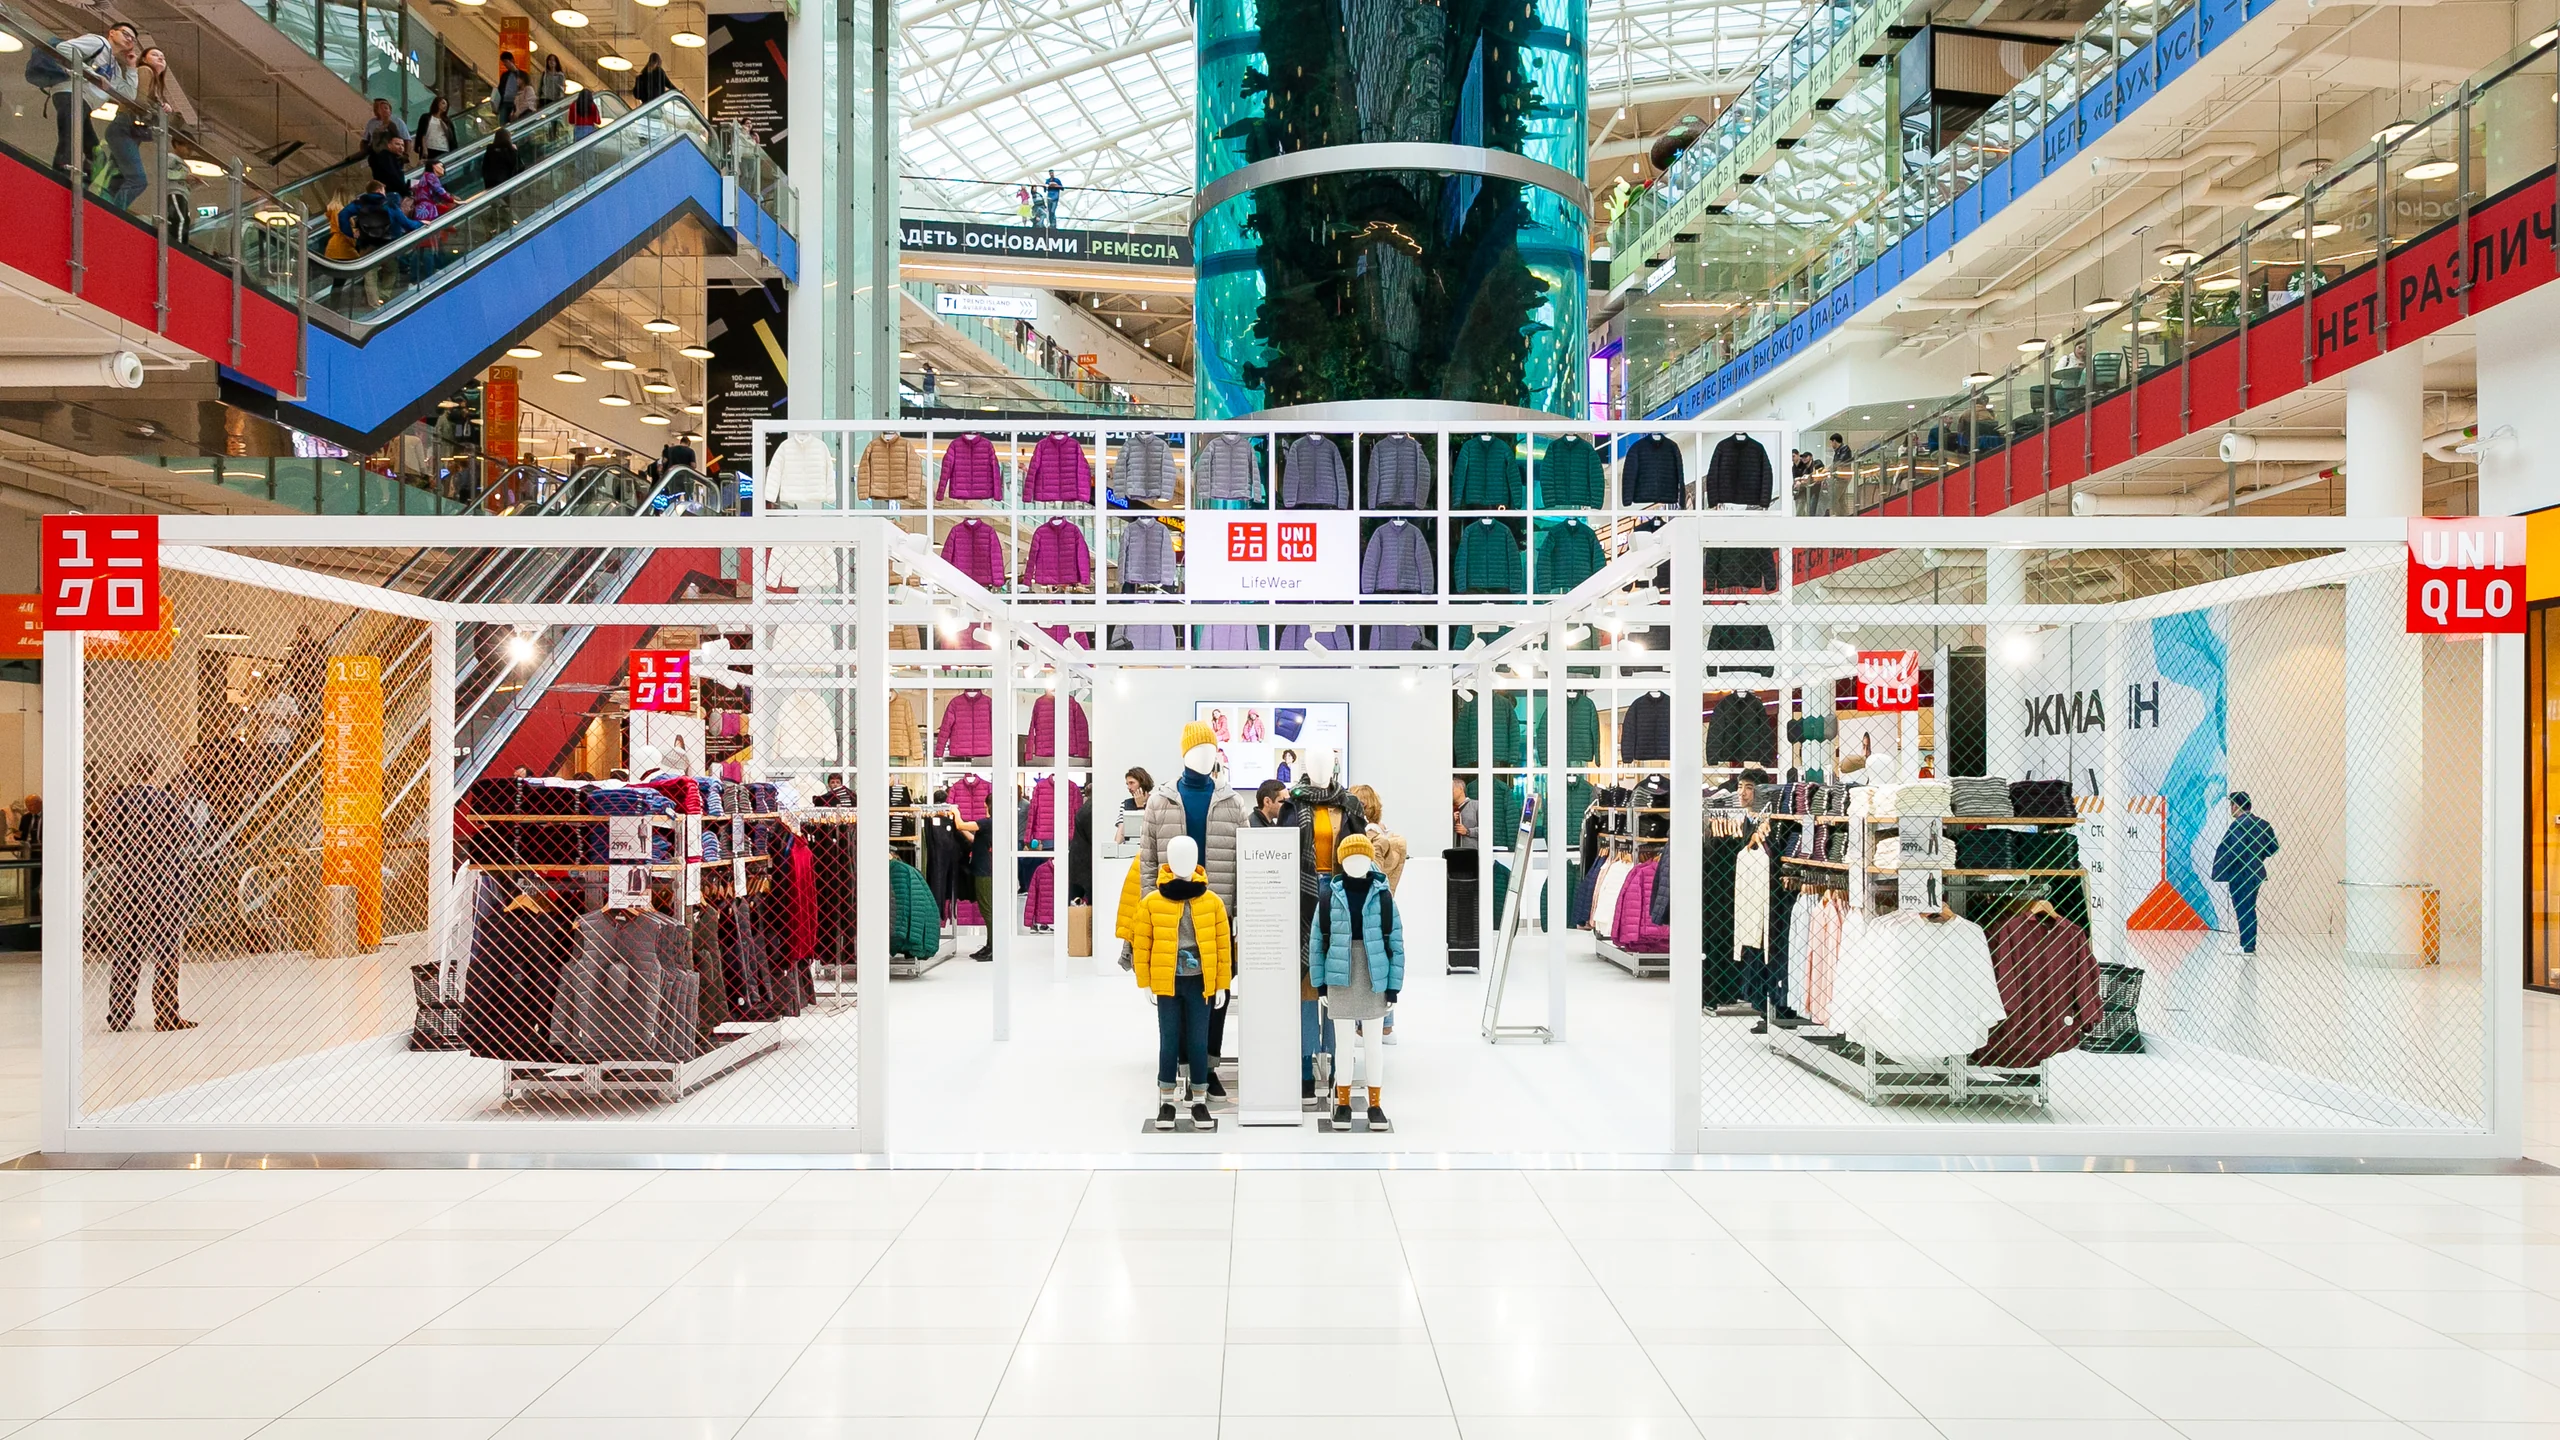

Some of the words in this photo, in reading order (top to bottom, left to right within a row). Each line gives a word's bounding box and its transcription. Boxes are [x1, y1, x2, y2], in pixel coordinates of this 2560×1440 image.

[965, 232, 1078, 254] ОСНОВАМИ
[1091, 240, 1179, 260] РЕМЕСЛА
[2317, 294, 2378, 357] НЕТ
[493, 368, 501, 380] 2
[1281, 526, 1310, 541] UNI
[1281, 543, 1314, 560] QLO
[2422, 531, 2505, 570] UNI
[1241, 576, 1302, 589] LifeWear
[2421, 579, 2513, 625] QLO
[1864, 658, 1909, 679] UNI
[1864, 683, 1912, 708] QLO
[1244, 850, 1293, 861] LifeWear
